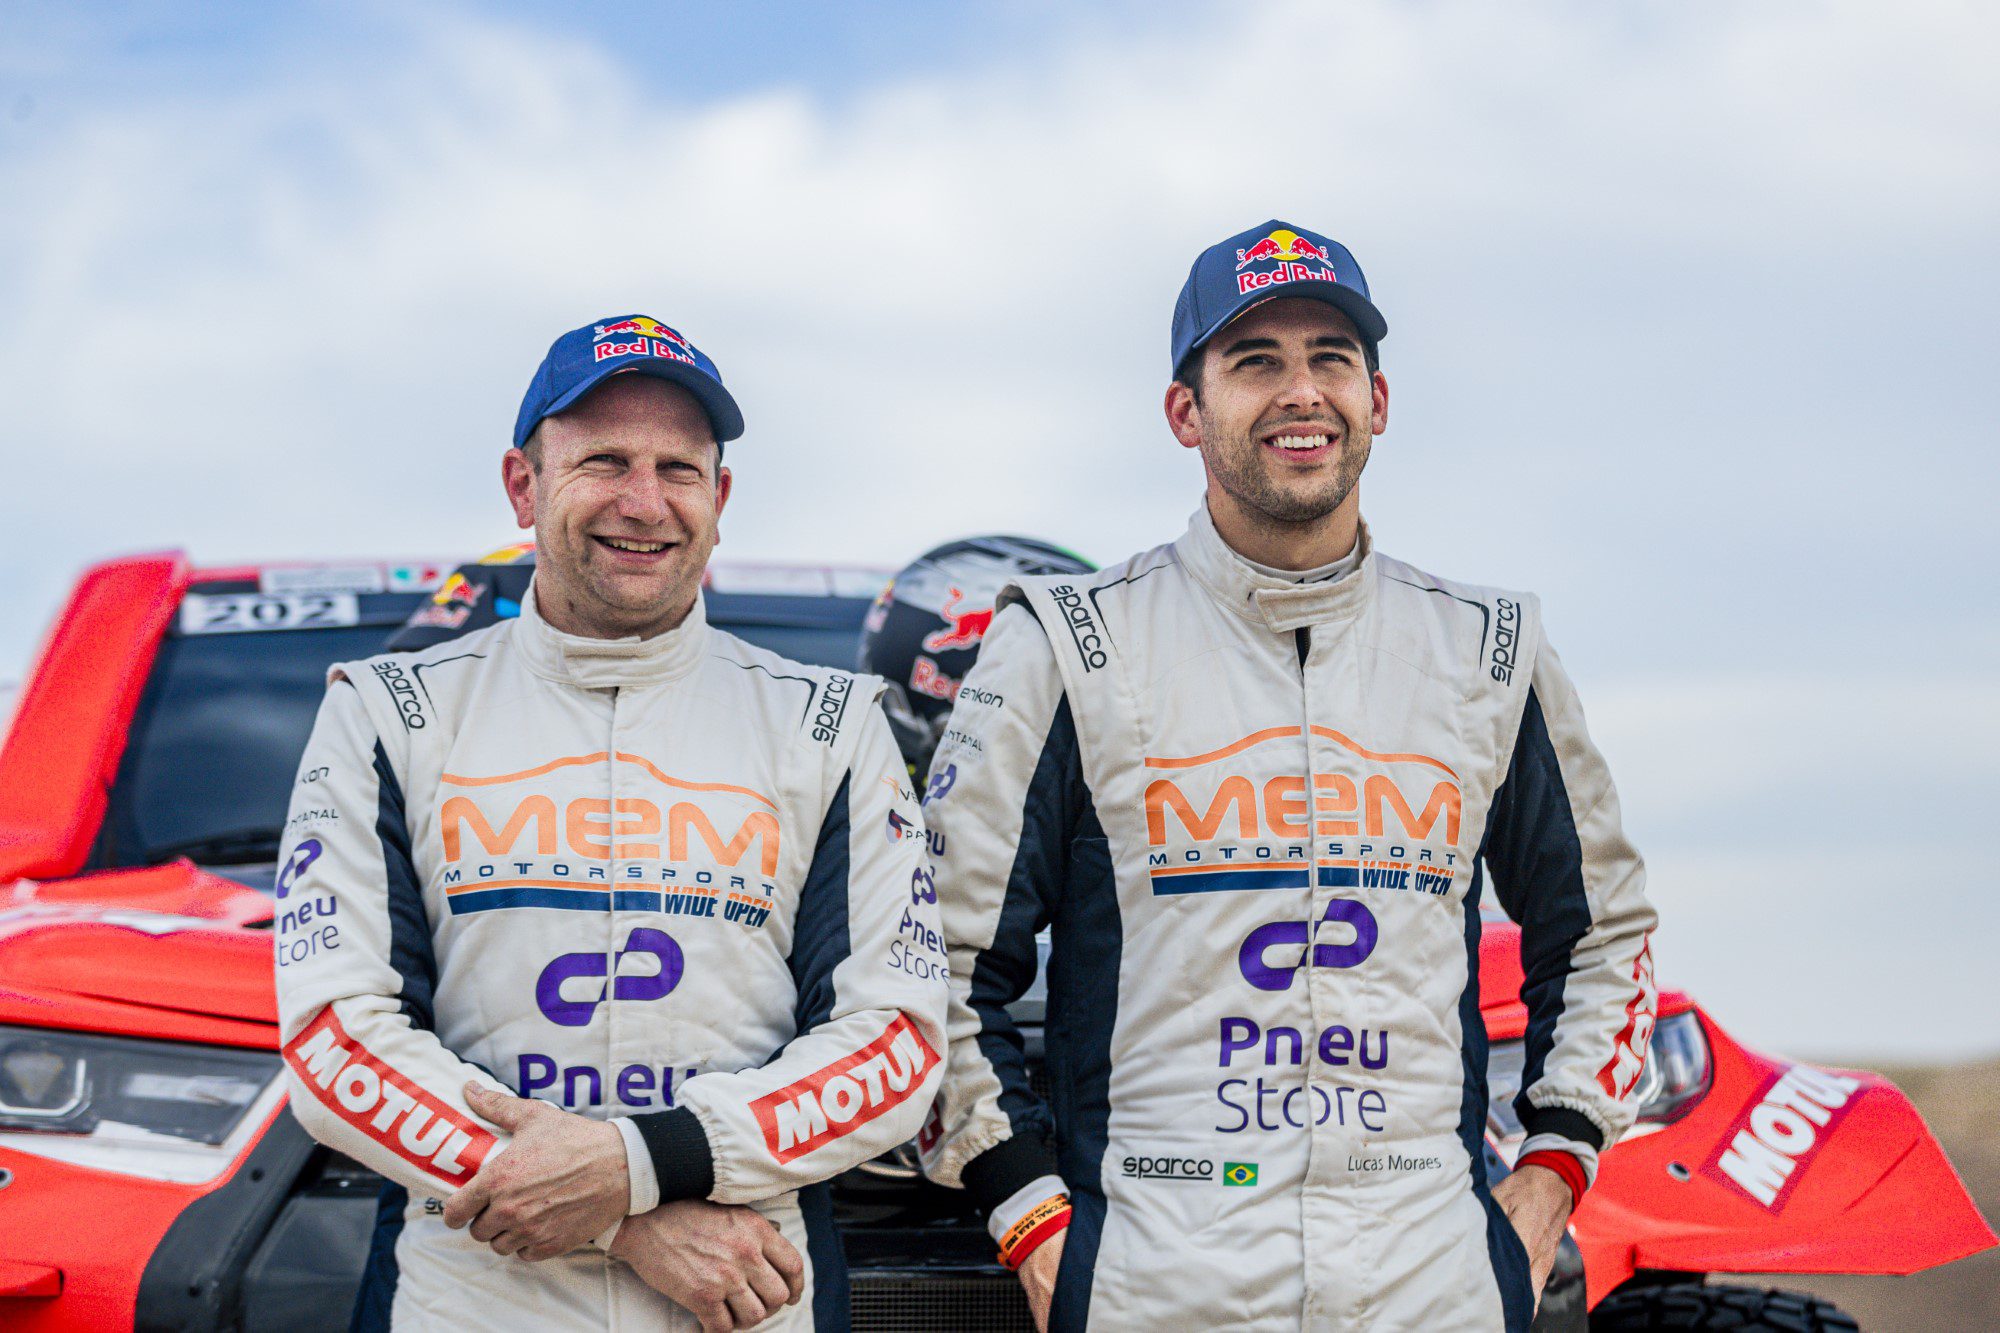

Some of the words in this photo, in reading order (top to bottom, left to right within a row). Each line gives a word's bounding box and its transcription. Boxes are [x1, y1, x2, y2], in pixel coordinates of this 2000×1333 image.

[1238, 262, 1289, 294] Red
[595, 337, 648, 361] Red
[204, 596, 336, 627] 202
[1052, 585, 1107, 671] sparco
[1491, 598, 1519, 685] sparco
[373, 662, 425, 731] sparco
[812, 675, 850, 744] sparco
[1149, 844, 1455, 866] MOTORSPORT
[445, 862, 774, 897] MOTORSPORT
[1362, 860, 1412, 890] WIDE
[1414, 863, 1456, 896] OPEN
[281, 896, 337, 935] neu
[664, 884, 720, 918] WIDE
[723, 892, 774, 928] OPEN
[279, 925, 340, 967] tore
[1219, 1016, 1389, 1070] Pneu
[295, 1027, 474, 1176] MOTUL
[774, 1027, 926, 1153] MOTUL
[1215, 1077, 1388, 1133] Store
[1717, 1065, 1860, 1207] MOTUL
[1122, 1156, 1214, 1180] sparco
[1347, 1155, 1384, 1171] Lucas
[1388, 1154, 1442, 1171] Moraes
